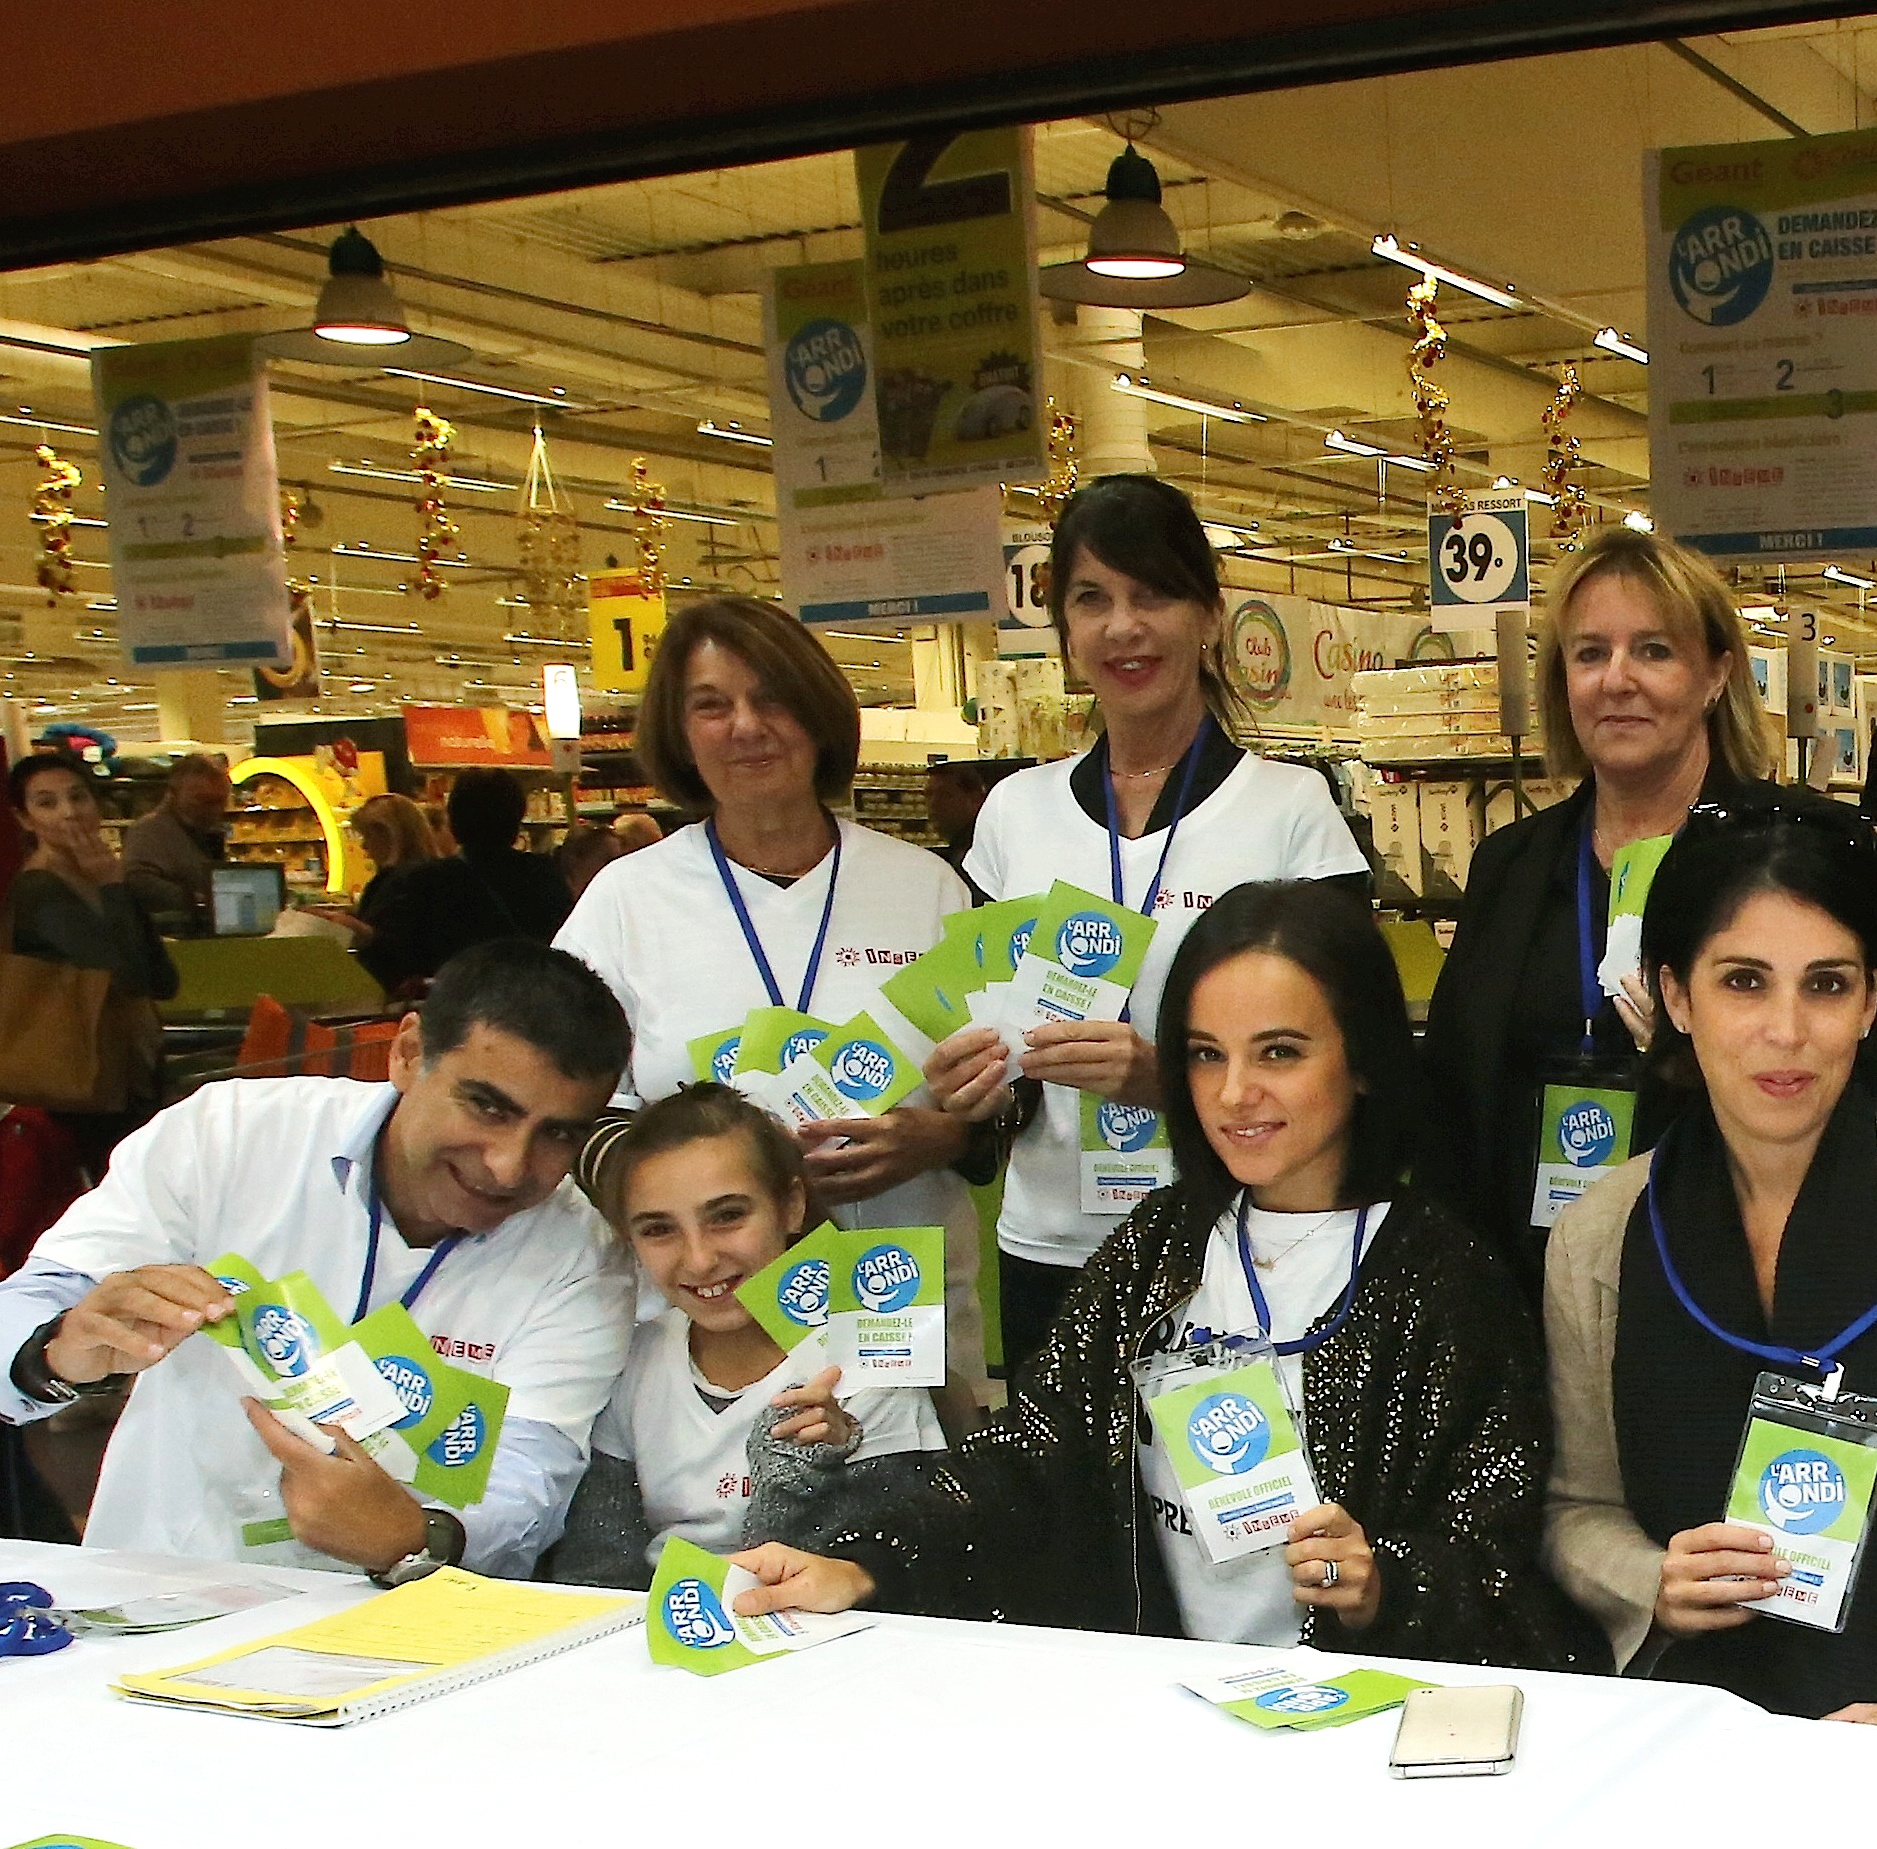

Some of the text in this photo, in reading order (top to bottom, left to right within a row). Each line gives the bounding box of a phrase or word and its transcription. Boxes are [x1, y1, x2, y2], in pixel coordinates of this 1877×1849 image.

[876, 245, 958, 269] heures
[1779, 241, 1802, 261] EN
[1808, 235, 1877, 259] CAISSE
[879, 268, 1010, 306] après dans
[880, 301, 1019, 338] votre coffre
[1701, 358, 1795, 395] 1 2
[1477, 498, 1522, 511] RESSORT
[1012, 532, 1053, 543] BLOUSO
[1759, 532, 1813, 549] MERCI
[1801, 612, 1816, 641] 3
[1245, 637, 1272, 657] Club
[1313, 629, 1385, 680] Casino
[1067, 918, 1111, 938] L'ARR
[1013, 934, 1031, 950] L'A
[864, 948, 927, 965] INSE
[852, 1042, 890, 1074] L'ARR
[1562, 1108, 1602, 1131] L'ARR
[857, 1250, 902, 1278] L'ARR
[780, 1264, 818, 1305] L'ARR
[396, 1386, 432, 1416] NDi
[1190, 1398, 1242, 1439] L'ARR
[1770, 1460, 1830, 1485] L'ARR
[1253, 1475, 1294, 1497] OFFICIEL
[1788, 1551, 1832, 1571] OFFICIEL
[668, 1593, 695, 1645] L'ARR
